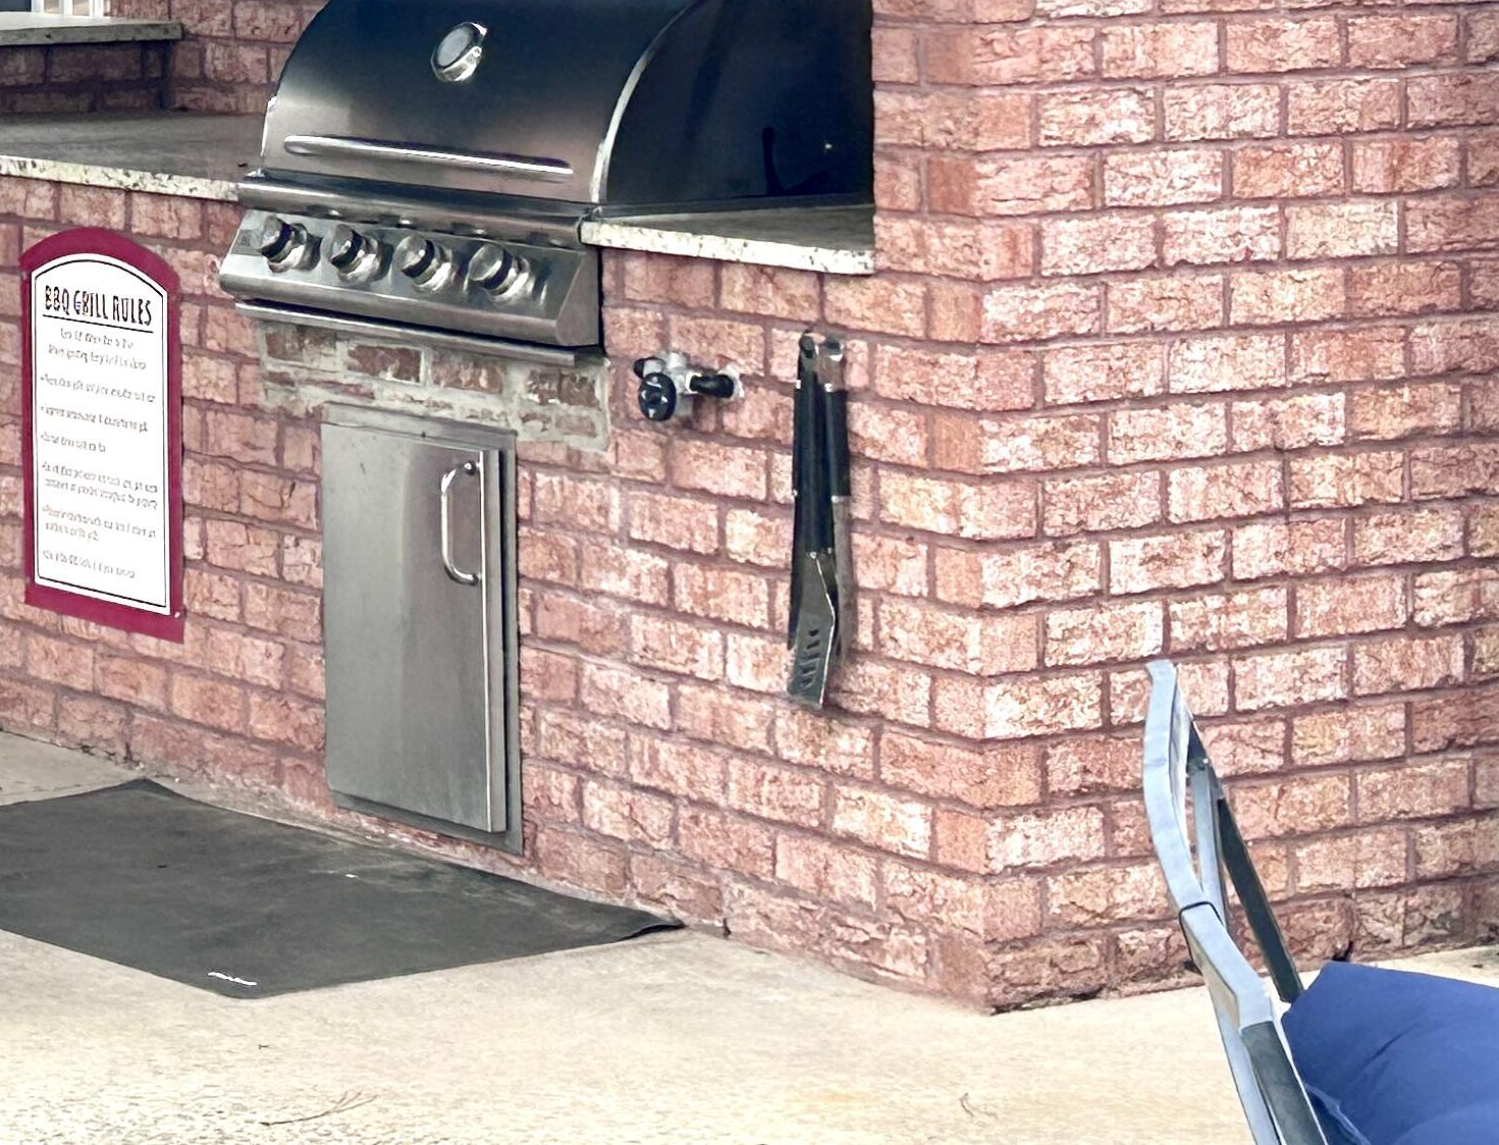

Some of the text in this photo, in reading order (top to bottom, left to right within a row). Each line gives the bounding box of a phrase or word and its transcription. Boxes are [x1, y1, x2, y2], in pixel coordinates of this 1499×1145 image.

[45, 285, 152, 326] BBQ GRILL RULES
